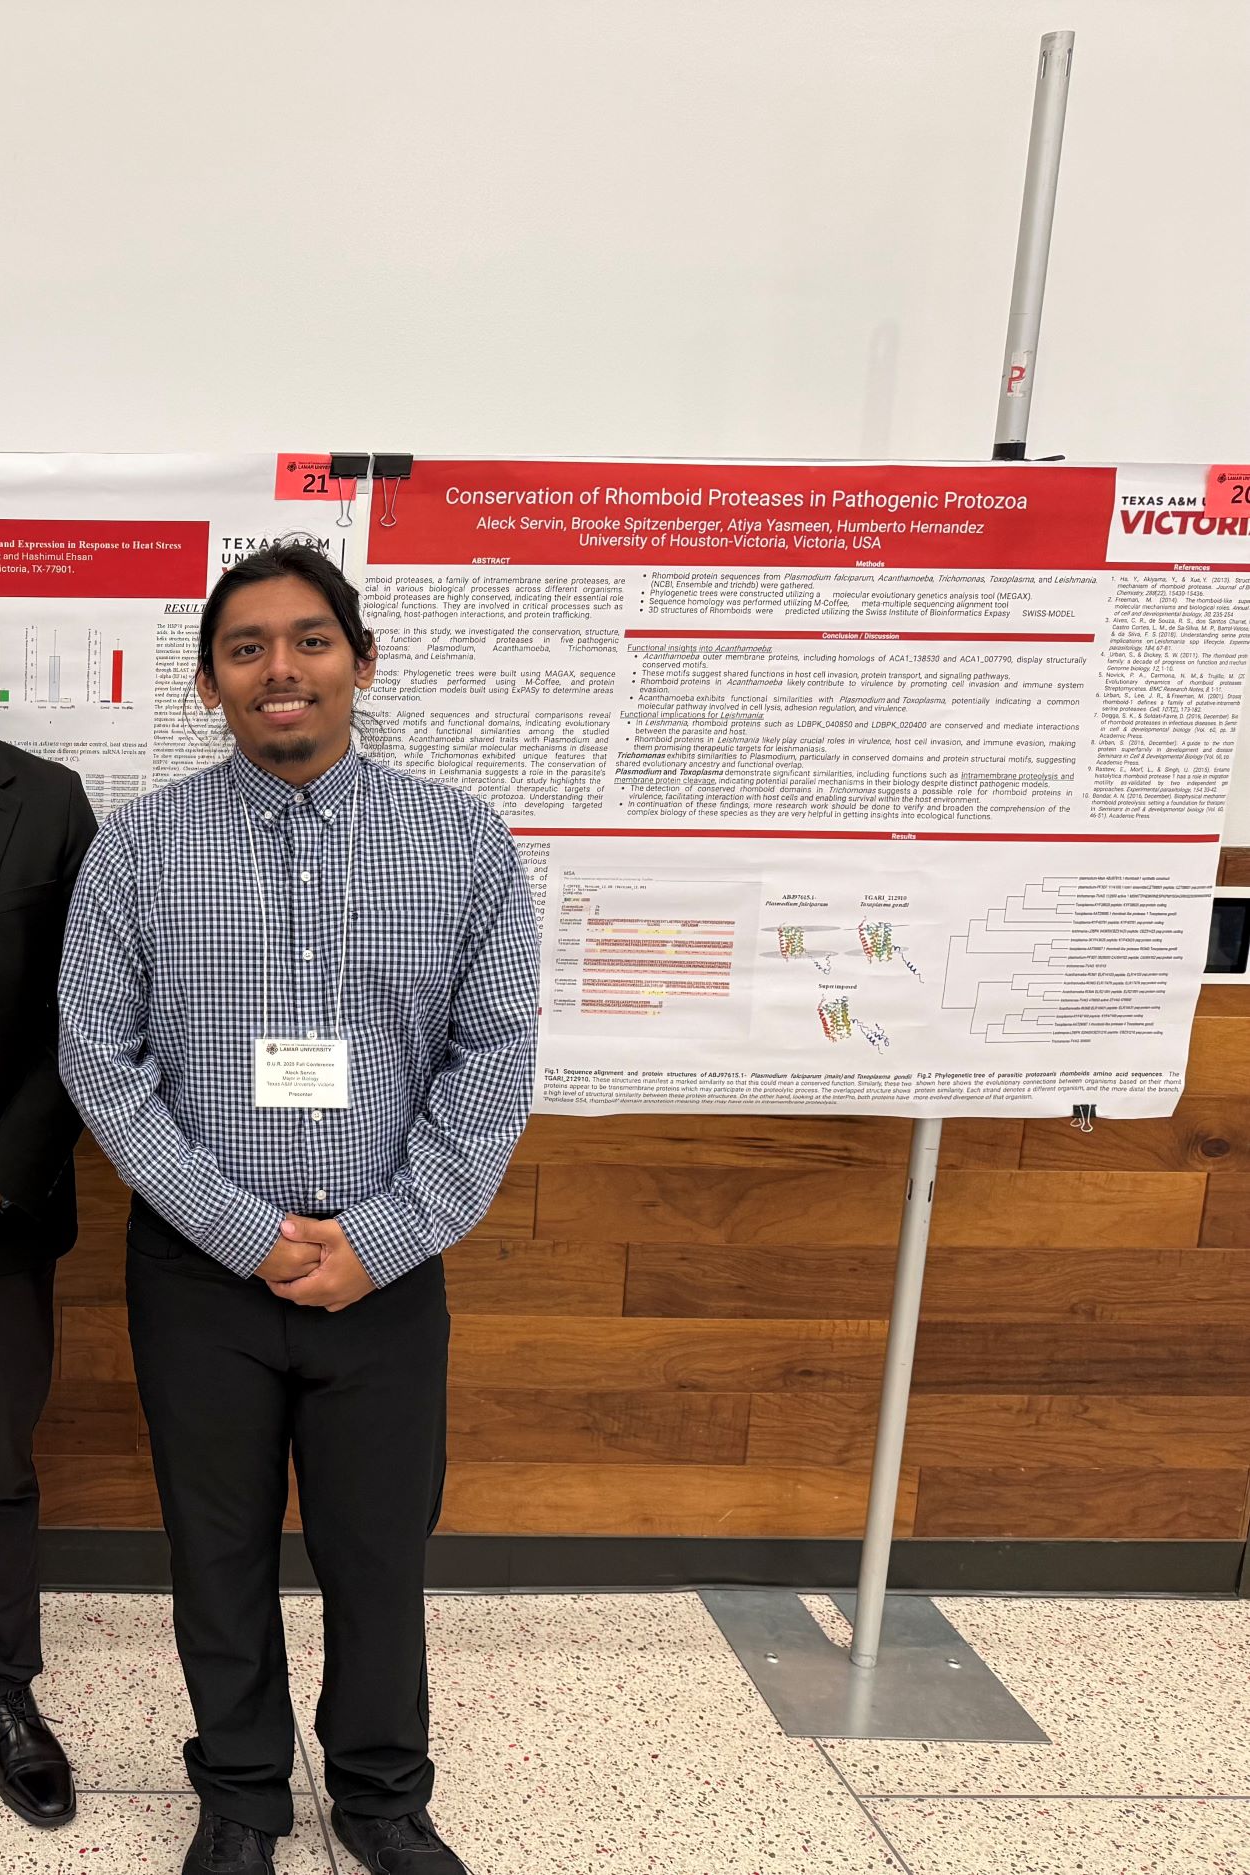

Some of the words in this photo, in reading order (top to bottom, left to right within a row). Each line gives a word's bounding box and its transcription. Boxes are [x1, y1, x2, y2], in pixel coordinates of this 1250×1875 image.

[303, 474, 328, 493] 21
[446, 487, 573, 504] Conservation
[579, 487, 600, 504] of
[605, 487, 701, 505] Rhomboid
[708, 489, 803, 506] Proteases
[810, 490, 825, 506] in
[832, 490, 938, 511] Pathogenic
[944, 491, 1027, 509] Protozoa
[1122, 496, 1164, 505] TEXAS
[1168, 497, 1197, 506] A&M
[476, 516, 515, 529] Aleck
[519, 516, 566, 530] Servin,
[571, 516, 620, 534] Brooke
[624, 517, 722, 535] Spitzenberger,
[727, 518, 761, 535] Atiya
[766, 519, 832, 533] Yasmeen,
[837, 520, 906, 532] Humberto
[910, 521, 984, 533] Hernandez
[1120, 510, 1250, 536] VICTORI
[17, 539, 64, 549] Expression
[67, 540, 75, 548] in
[78, 540, 119, 550] Response
[132, 541, 153, 549] Heat
[155, 541, 181, 549] Stress
[579, 533, 647, 548] University
[651, 533, 666, 546] of
[669, 534, 788, 548] Houston-Victoria,
[793, 535, 847, 549] Victoria,
[852, 536, 881, 548] USA
[21, 552, 64, 560] Hashimul
[65, 552, 92, 560] Ehsan
[31, 564, 74, 573] TX-77901.
[822, 632, 858, 640] Conclusion
